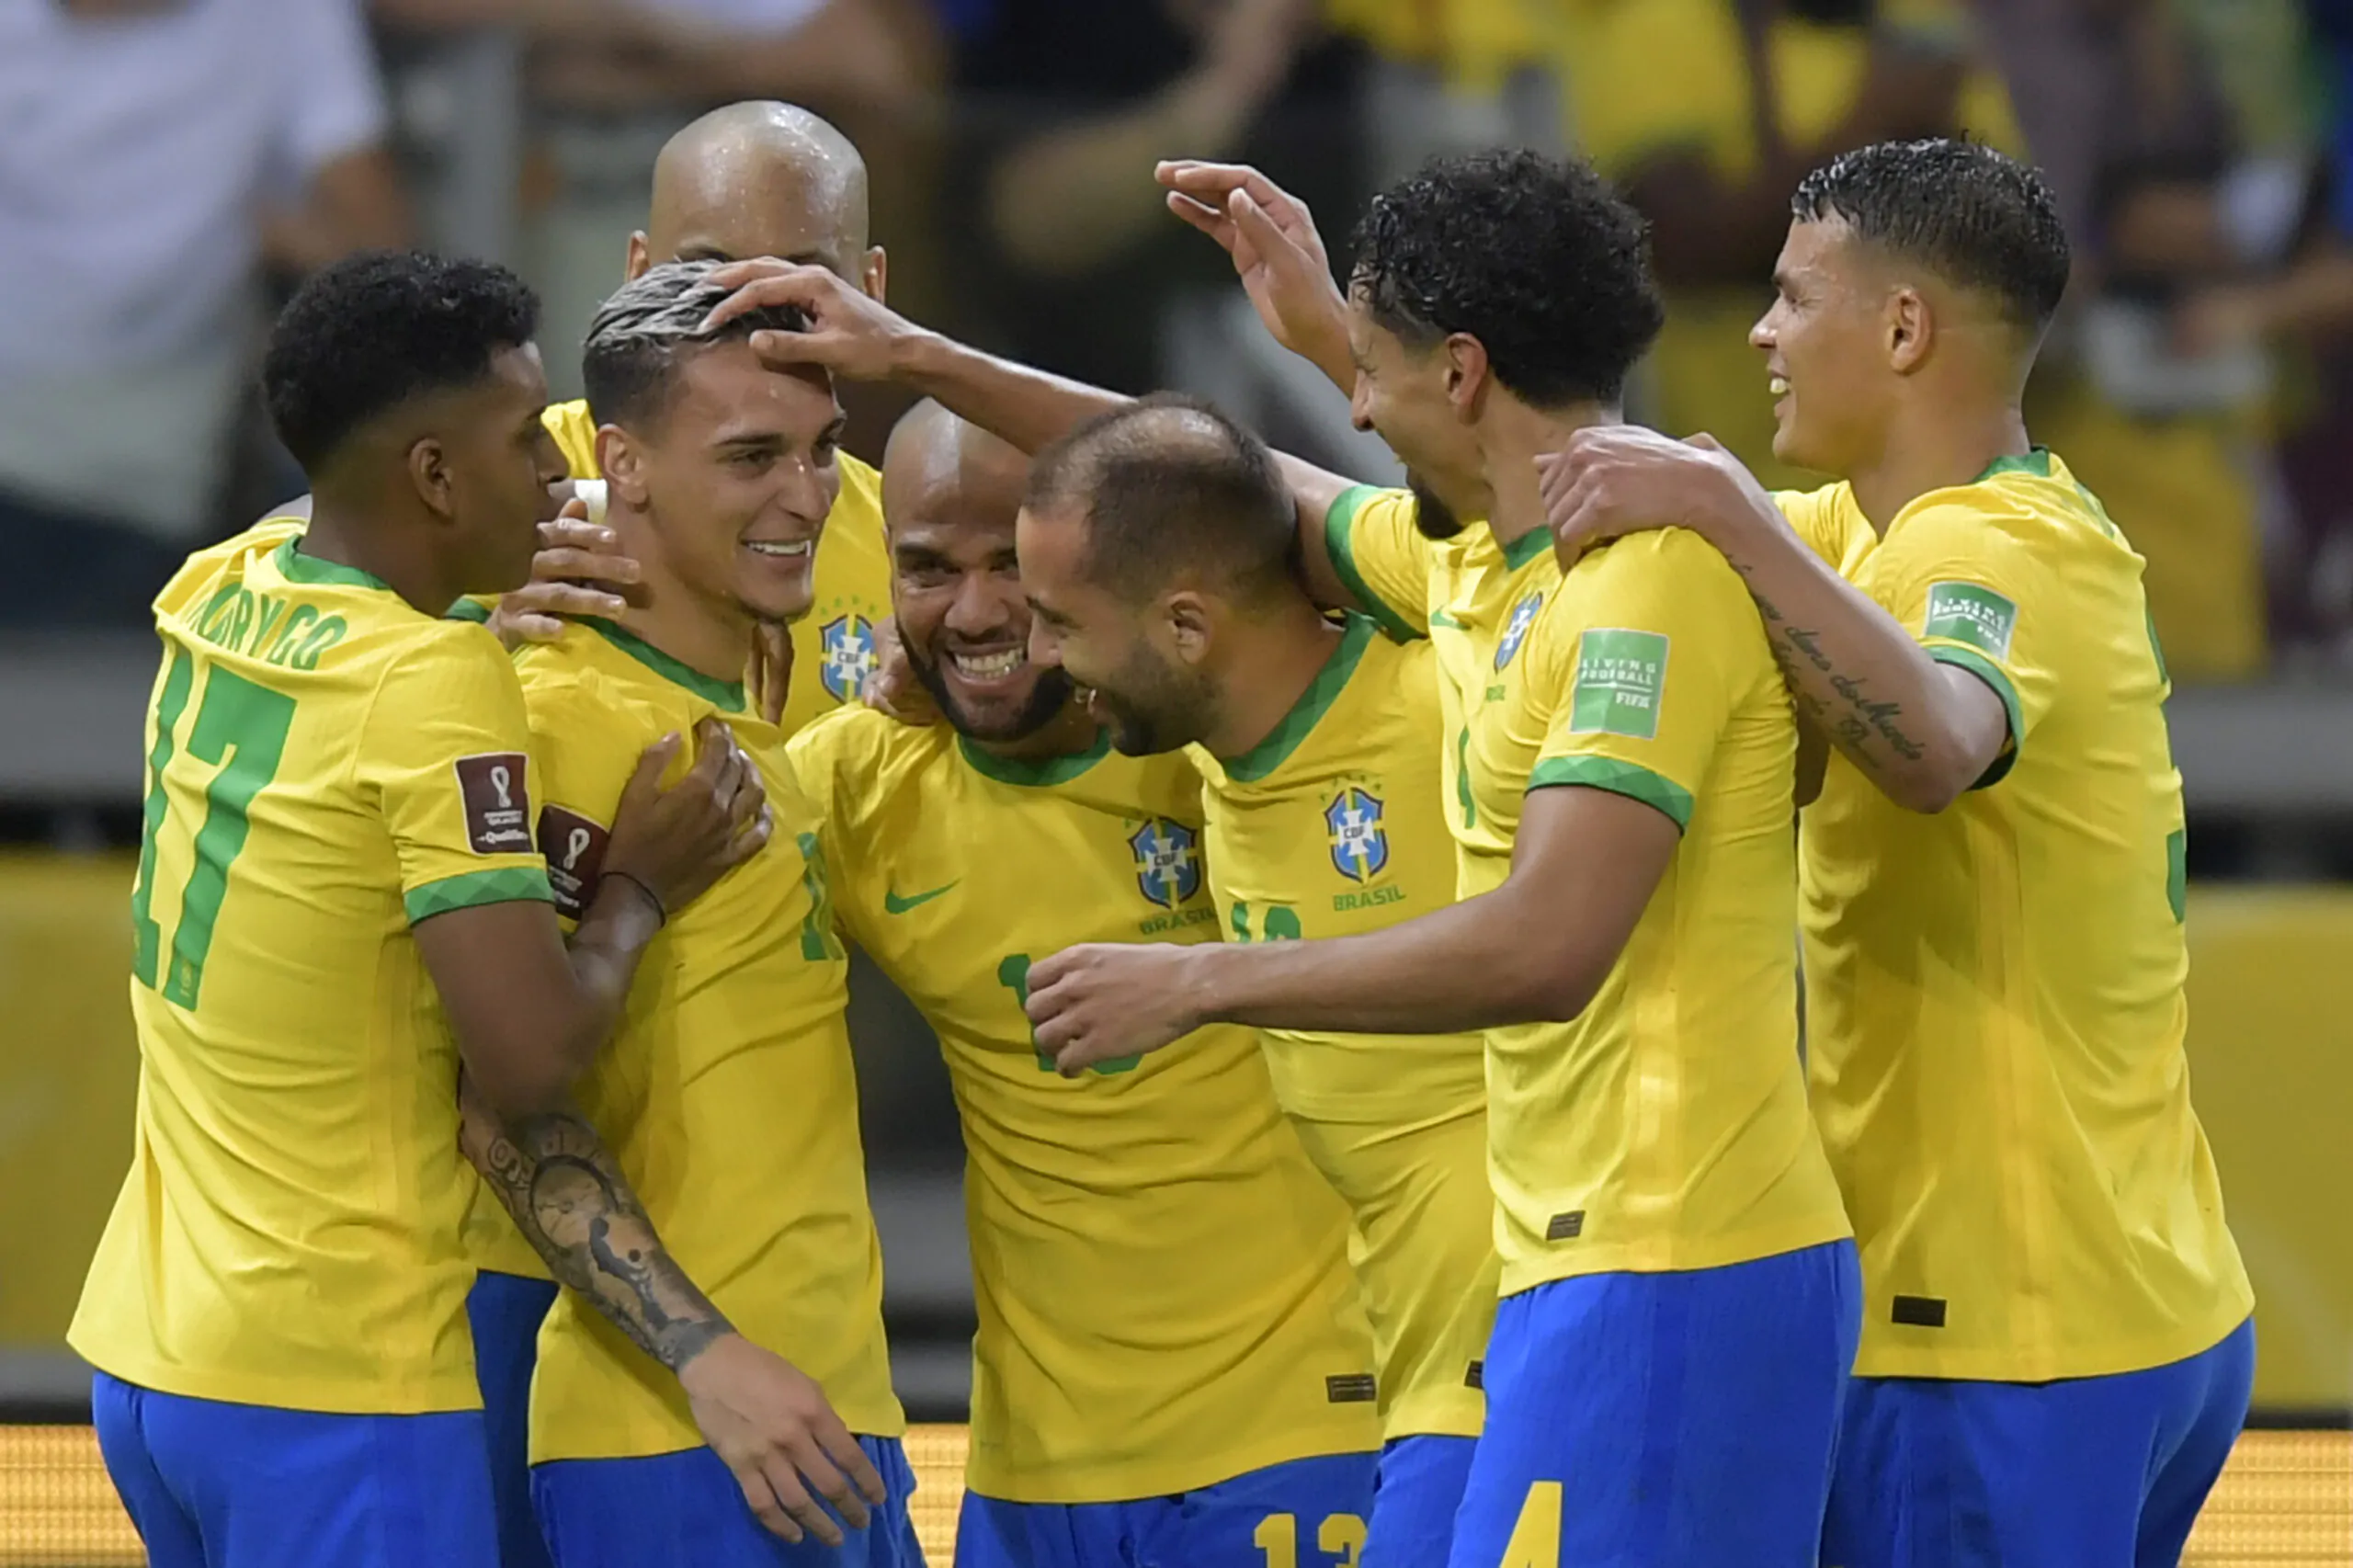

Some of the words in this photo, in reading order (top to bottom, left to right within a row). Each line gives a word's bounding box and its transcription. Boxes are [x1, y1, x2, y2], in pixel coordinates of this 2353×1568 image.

[1582, 657, 1656, 674] LIVING
[1615, 691, 1650, 709] FIFA
[1333, 883, 1407, 912] BRASIL
[1140, 905, 1216, 936] BRASIL
